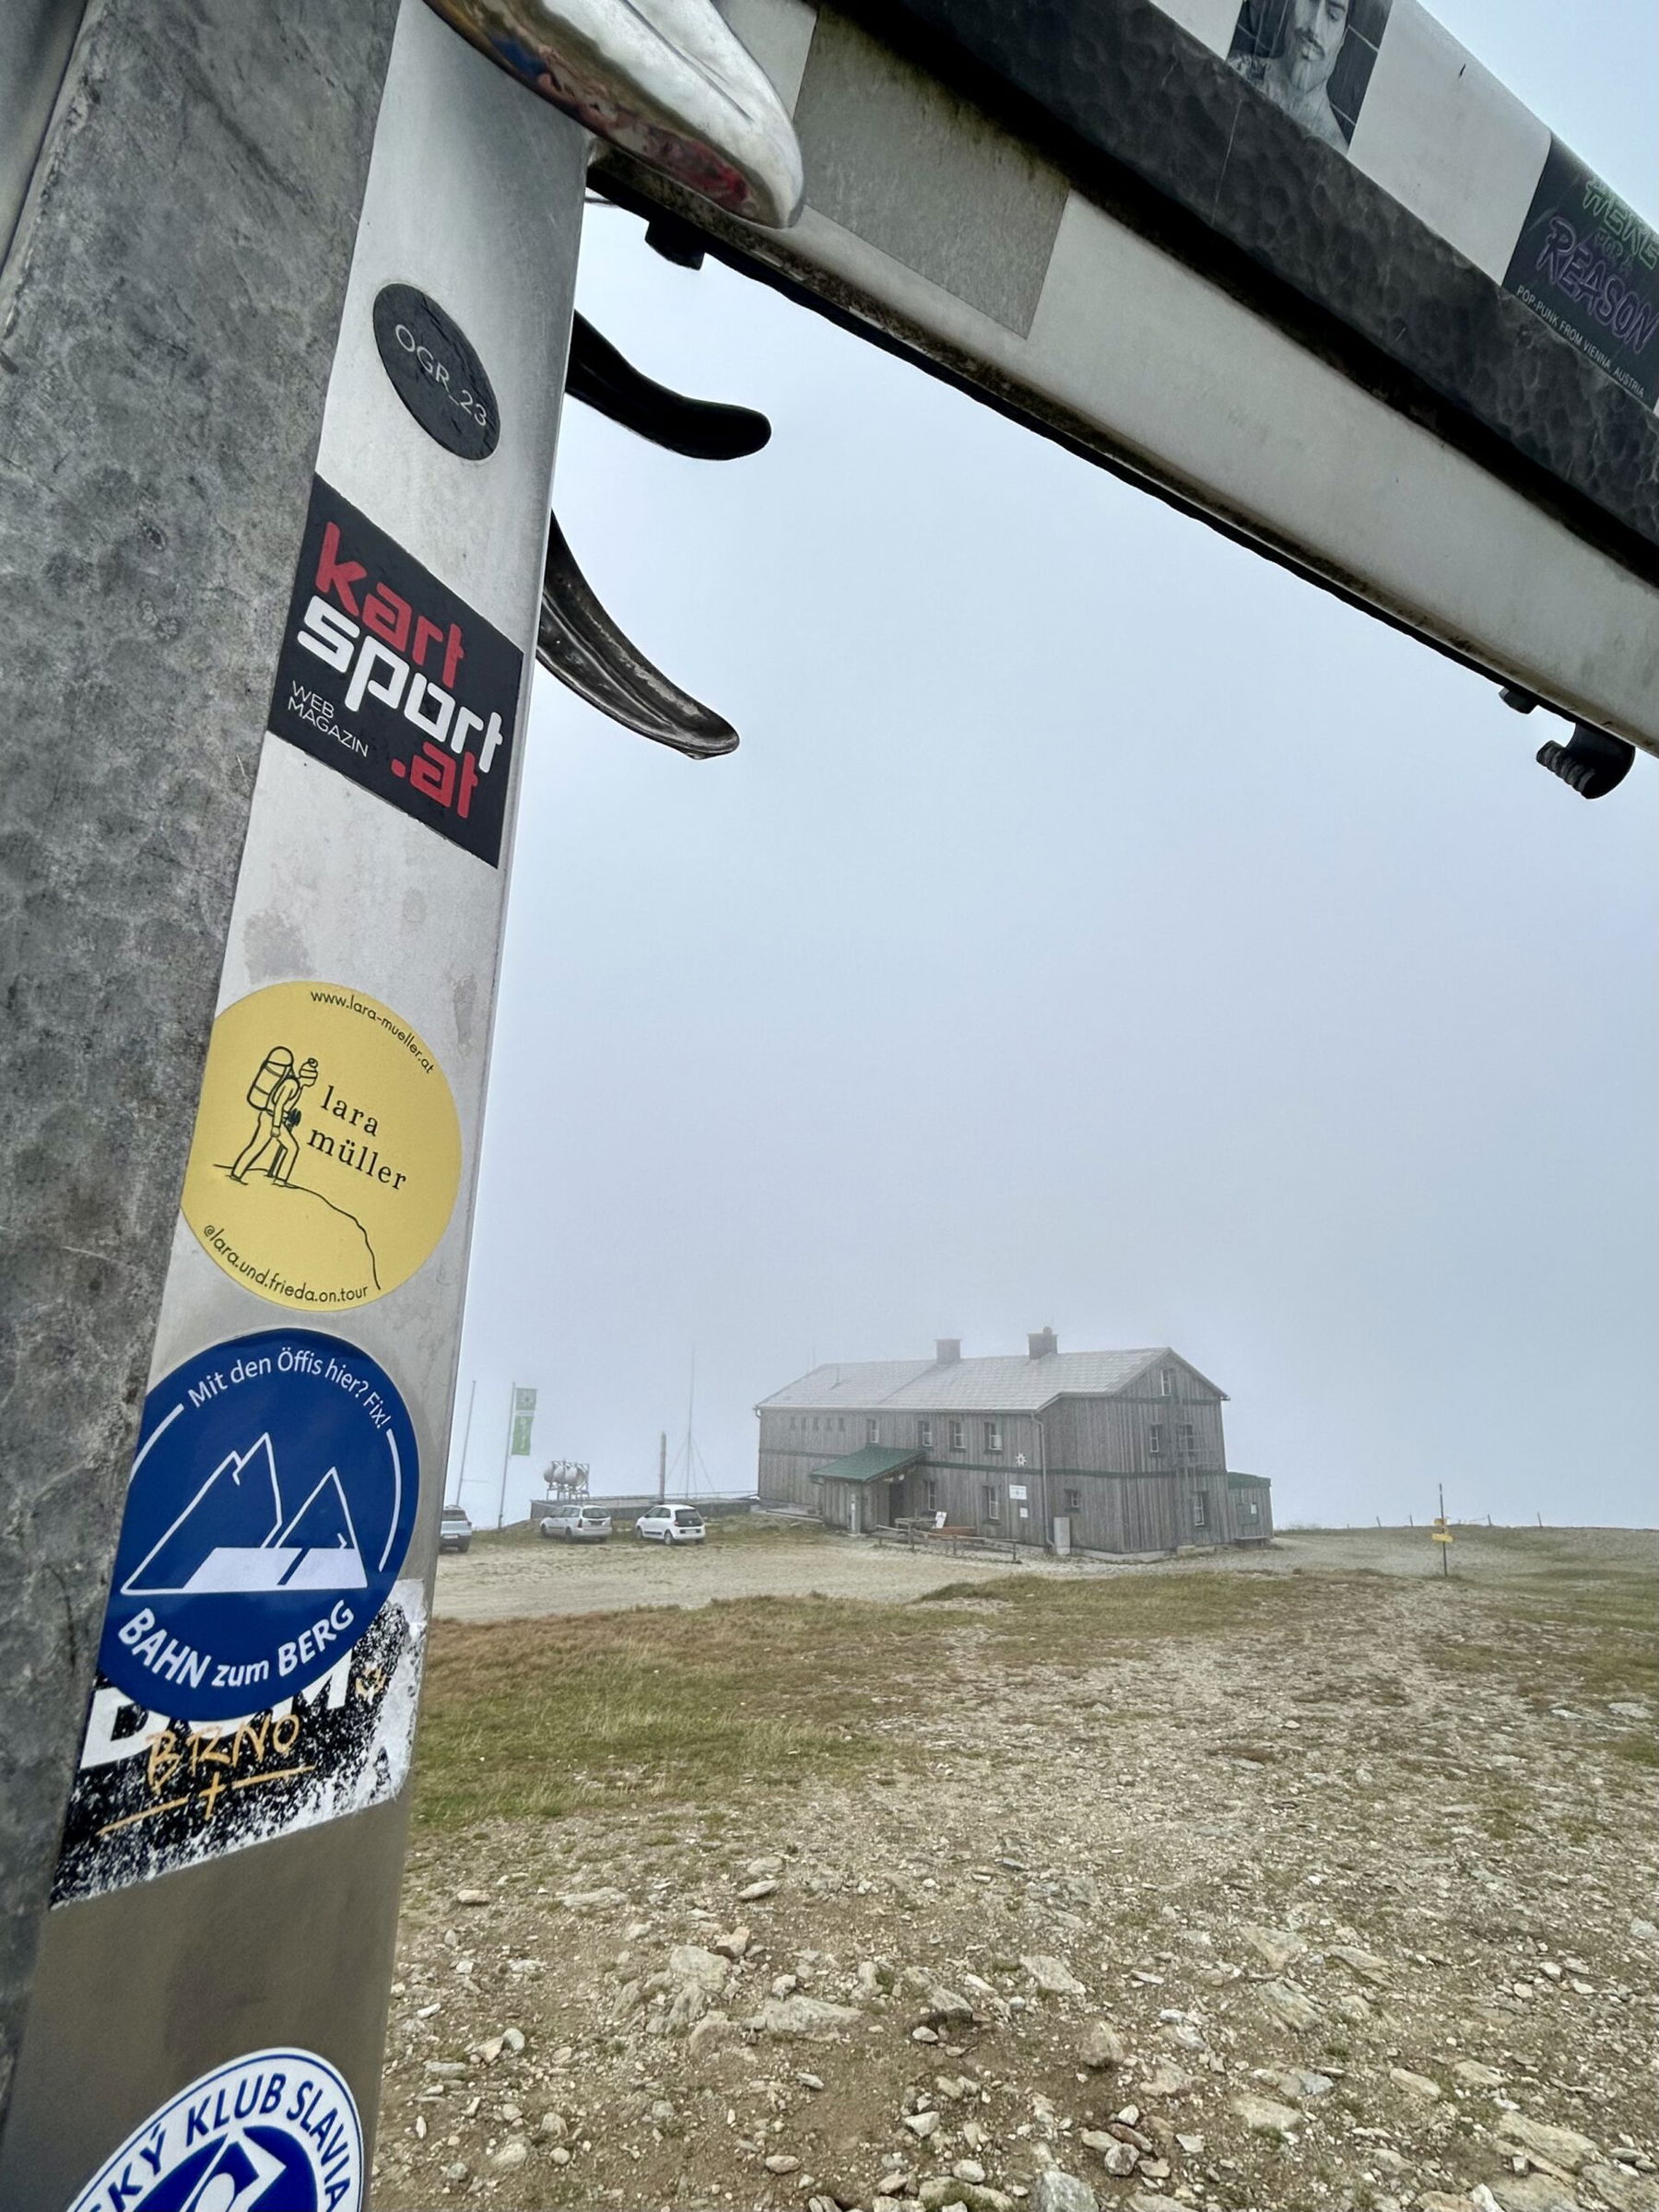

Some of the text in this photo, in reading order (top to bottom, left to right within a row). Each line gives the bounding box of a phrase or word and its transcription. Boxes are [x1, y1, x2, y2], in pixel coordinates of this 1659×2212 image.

[1536, 216, 1659, 354] REASON
[394, 324, 488, 427] OGR_23
[1559, 320, 1583, 349] FROM
[1613, 366, 1644, 398] AUSTRIA
[314, 521, 465, 688] kart
[292, 680, 335, 719] WEB
[297, 595, 502, 773] sport
[288, 696, 369, 758] MAGAZIN
[390, 742, 479, 818] .at
[310, 990, 435, 1075] www.lara-mueller.at
[320, 1085, 380, 1136] lara
[306, 1125, 406, 1191] müller
[203, 1224, 369, 1304] @lara.und.frieda.on.tour
[187, 1347, 392, 1430] Mit den Öffis hier? Fix!
[118, 1599, 356, 1688] BAHN zum BERG
[88, 2072, 352, 2212] KÝ KLUB SLAVIA
